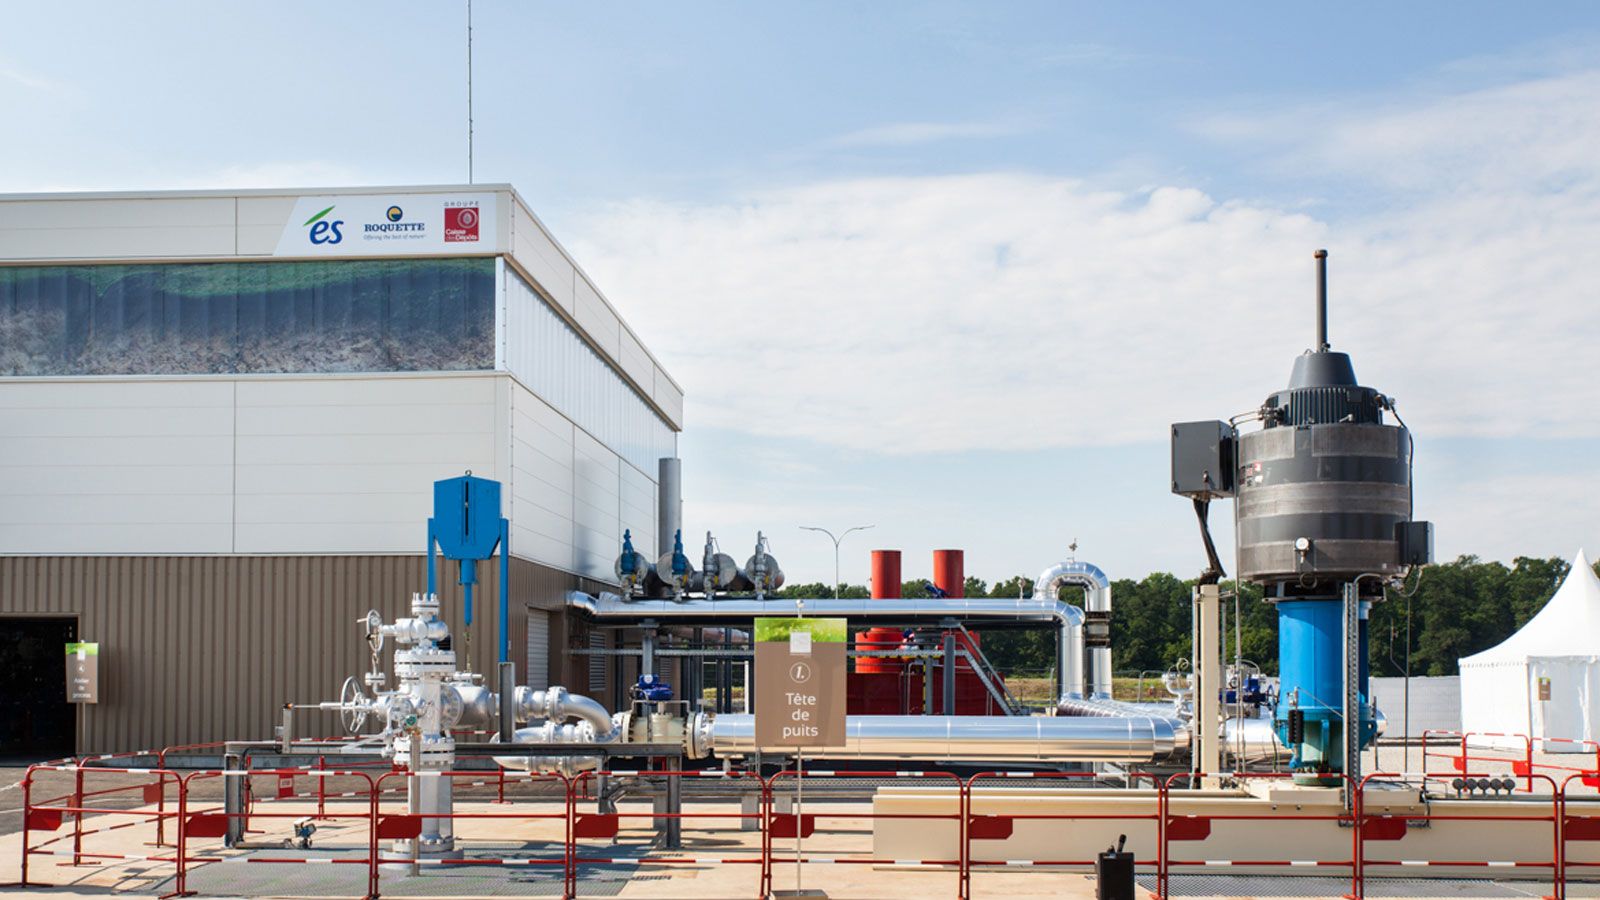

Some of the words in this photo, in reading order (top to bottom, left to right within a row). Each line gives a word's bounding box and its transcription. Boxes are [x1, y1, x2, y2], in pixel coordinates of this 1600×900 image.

[364, 223, 425, 232] ROQUETTE
[785, 692, 817, 706] Tête
[791, 708, 810, 721] de
[782, 723, 819, 740] puits
